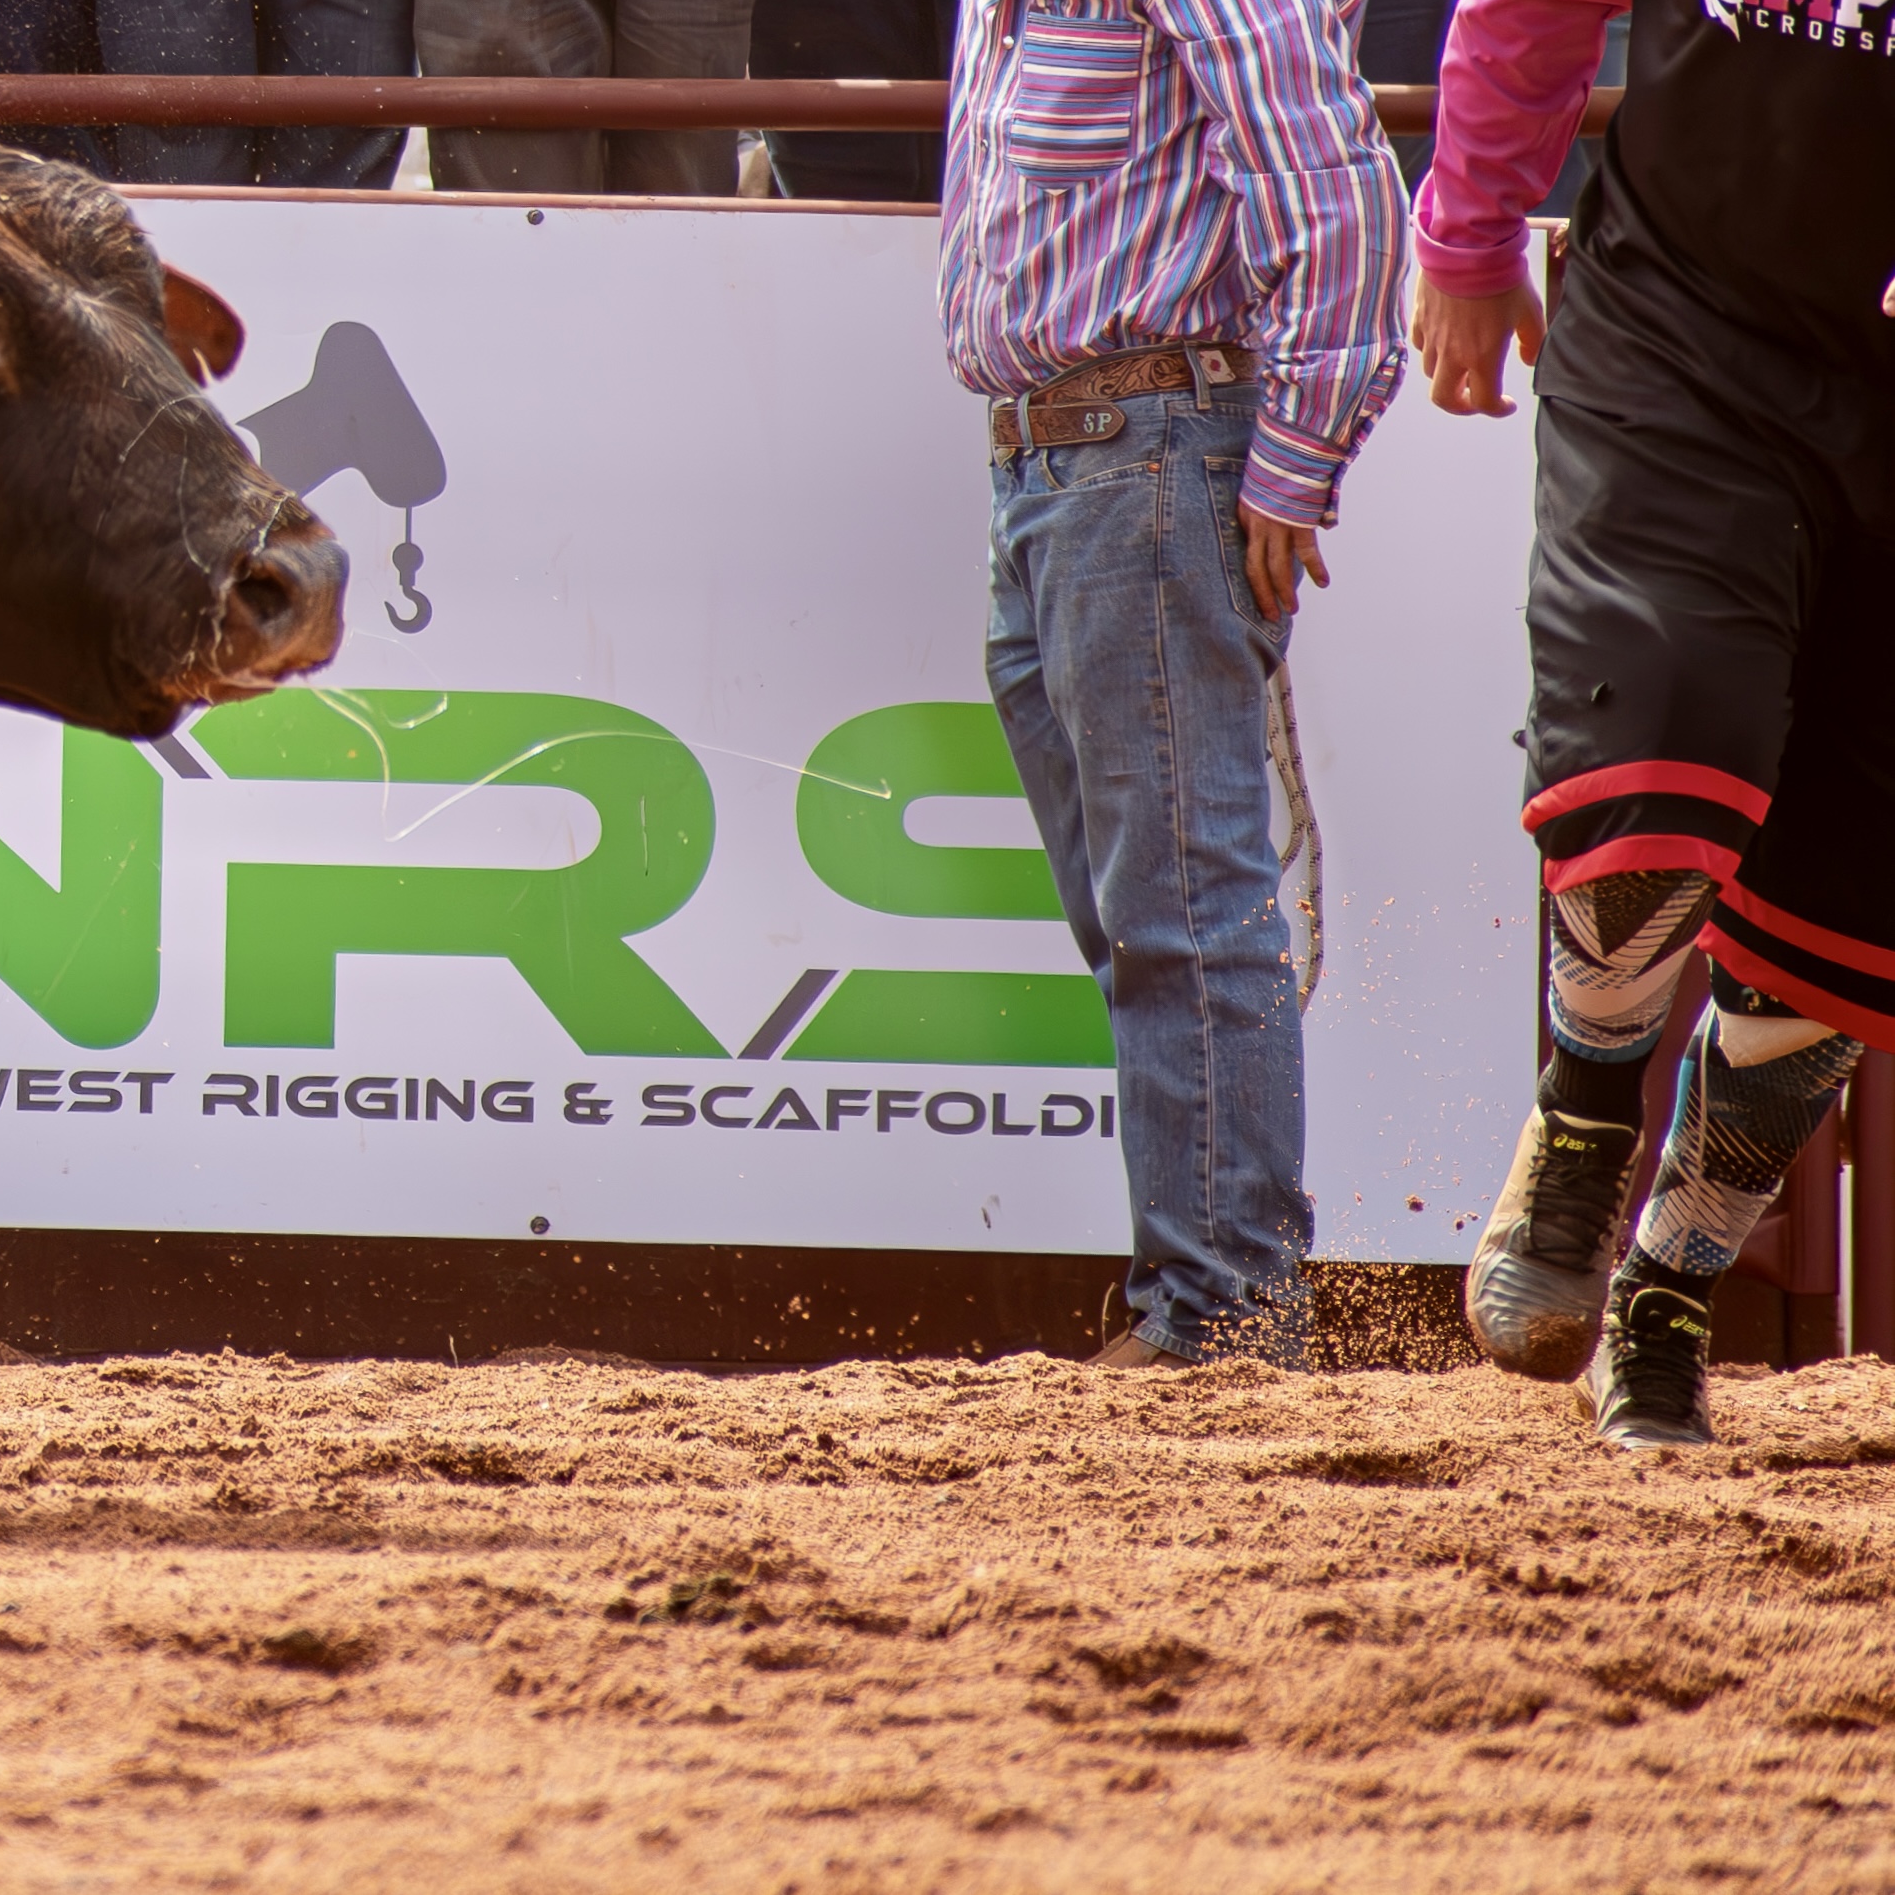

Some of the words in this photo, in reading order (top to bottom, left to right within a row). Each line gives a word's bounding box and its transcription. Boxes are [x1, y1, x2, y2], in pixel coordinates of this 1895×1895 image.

[1083, 412, 1113, 434] SP
[202, 1073, 536, 1124] RIGGING
[563, 1082, 615, 1126] &
[639, 1083, 1115, 1138] SCAFFOLDI
